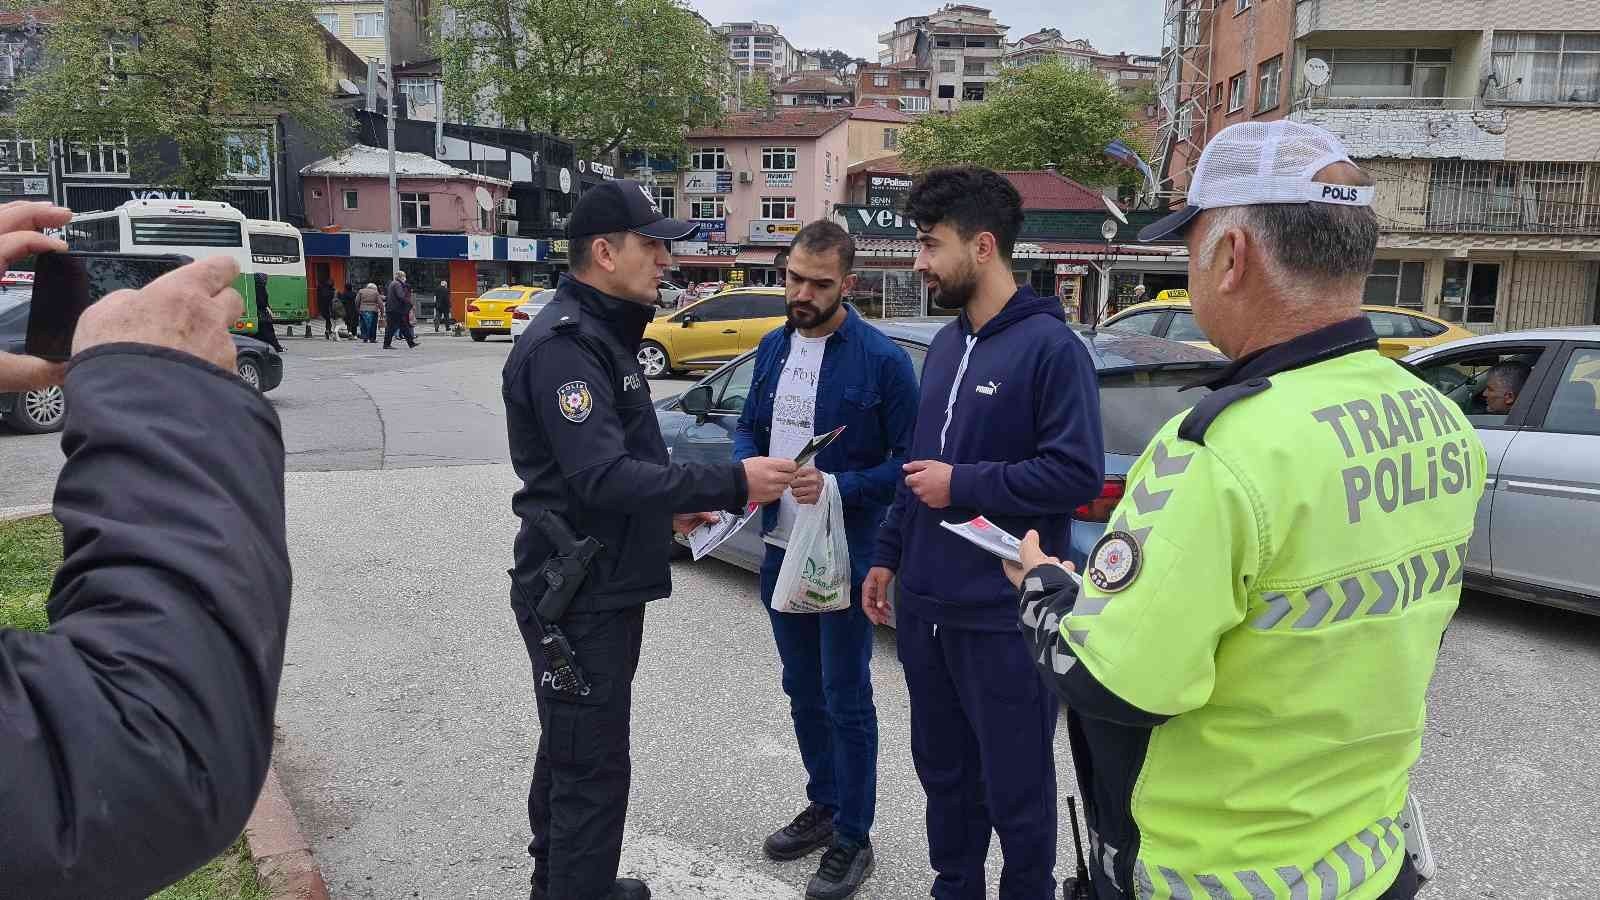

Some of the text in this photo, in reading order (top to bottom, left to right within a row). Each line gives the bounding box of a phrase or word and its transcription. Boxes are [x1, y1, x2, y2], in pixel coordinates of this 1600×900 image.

[884, 177, 912, 187] Polisan
[1311, 387, 1460, 458] TRAFİK
[1341, 438, 1472, 524] POLİSİ
